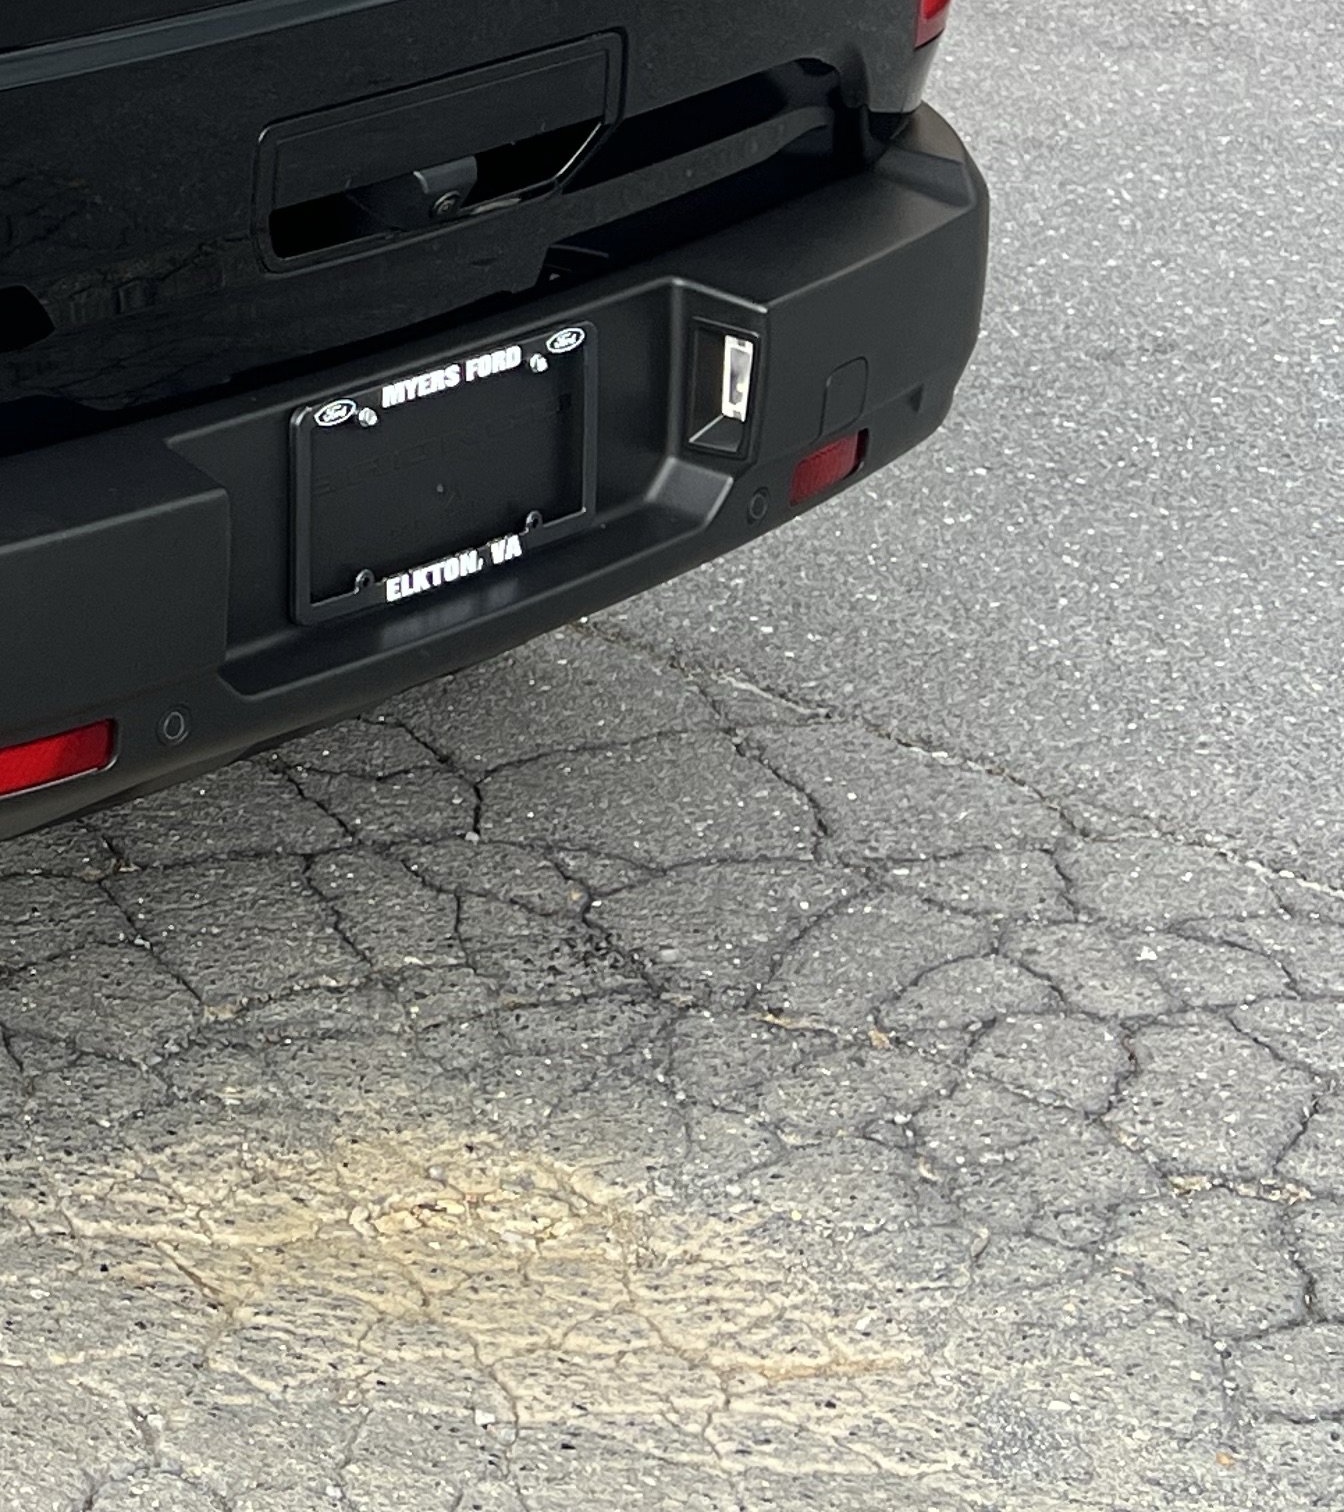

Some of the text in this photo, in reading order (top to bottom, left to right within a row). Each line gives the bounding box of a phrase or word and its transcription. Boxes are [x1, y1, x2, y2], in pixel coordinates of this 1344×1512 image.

[381, 363, 462, 409] MYERS
[465, 344, 523, 383] FORD
[488, 533, 523, 566] VA
